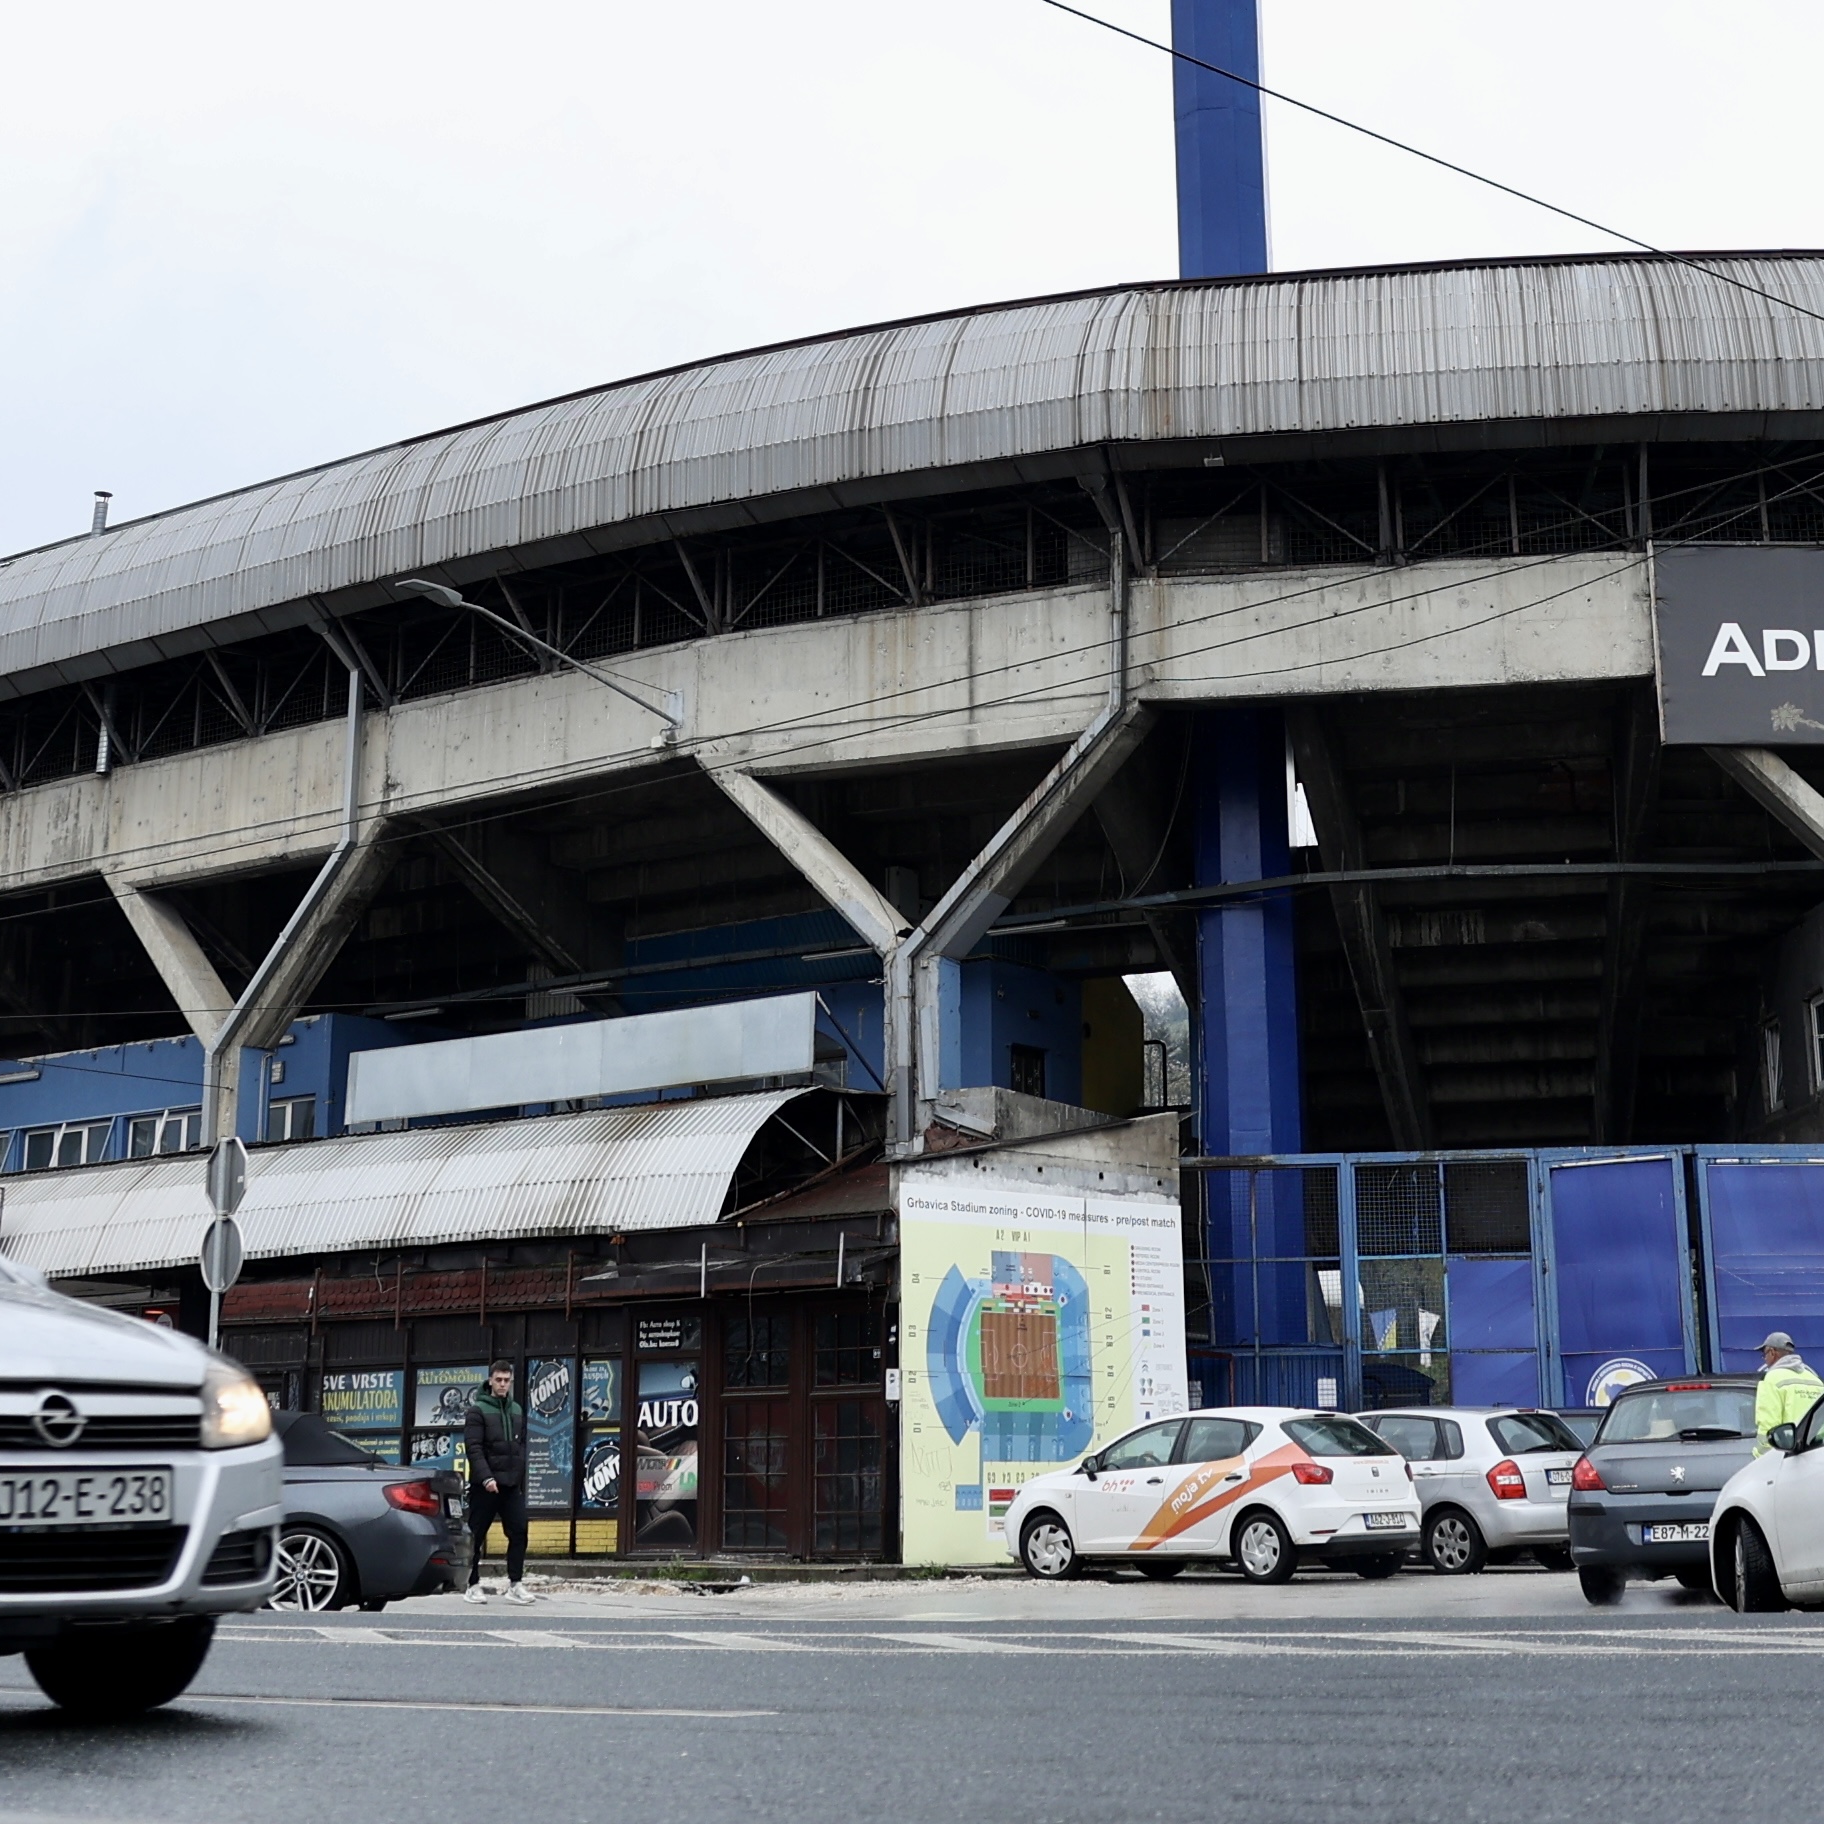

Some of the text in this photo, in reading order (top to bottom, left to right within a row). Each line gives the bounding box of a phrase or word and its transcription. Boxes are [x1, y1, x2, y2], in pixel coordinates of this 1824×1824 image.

[907, 1197, 948, 1211] Grbavica
[950, 1200, 987, 1214] Stadium
[989, 1205, 1018, 1219] zoning
[1026, 1208, 1067, 1221] COVID-19
[1068, 1212, 1109, 1224] measures
[1116, 1215, 1149, 1227] pre/post
[1151, 1217, 1176, 1229] match
[1012, 1231, 1021, 1242] VIP
[323, 1372, 394, 1391] SVE VRSTE
[530, 1366, 570, 1409] KONTA
[322, 1389, 399, 1411] AKUMULATORA
[637, 1399, 699, 1428] AUTO
[1171, 1466, 1215, 1514] moja tv
